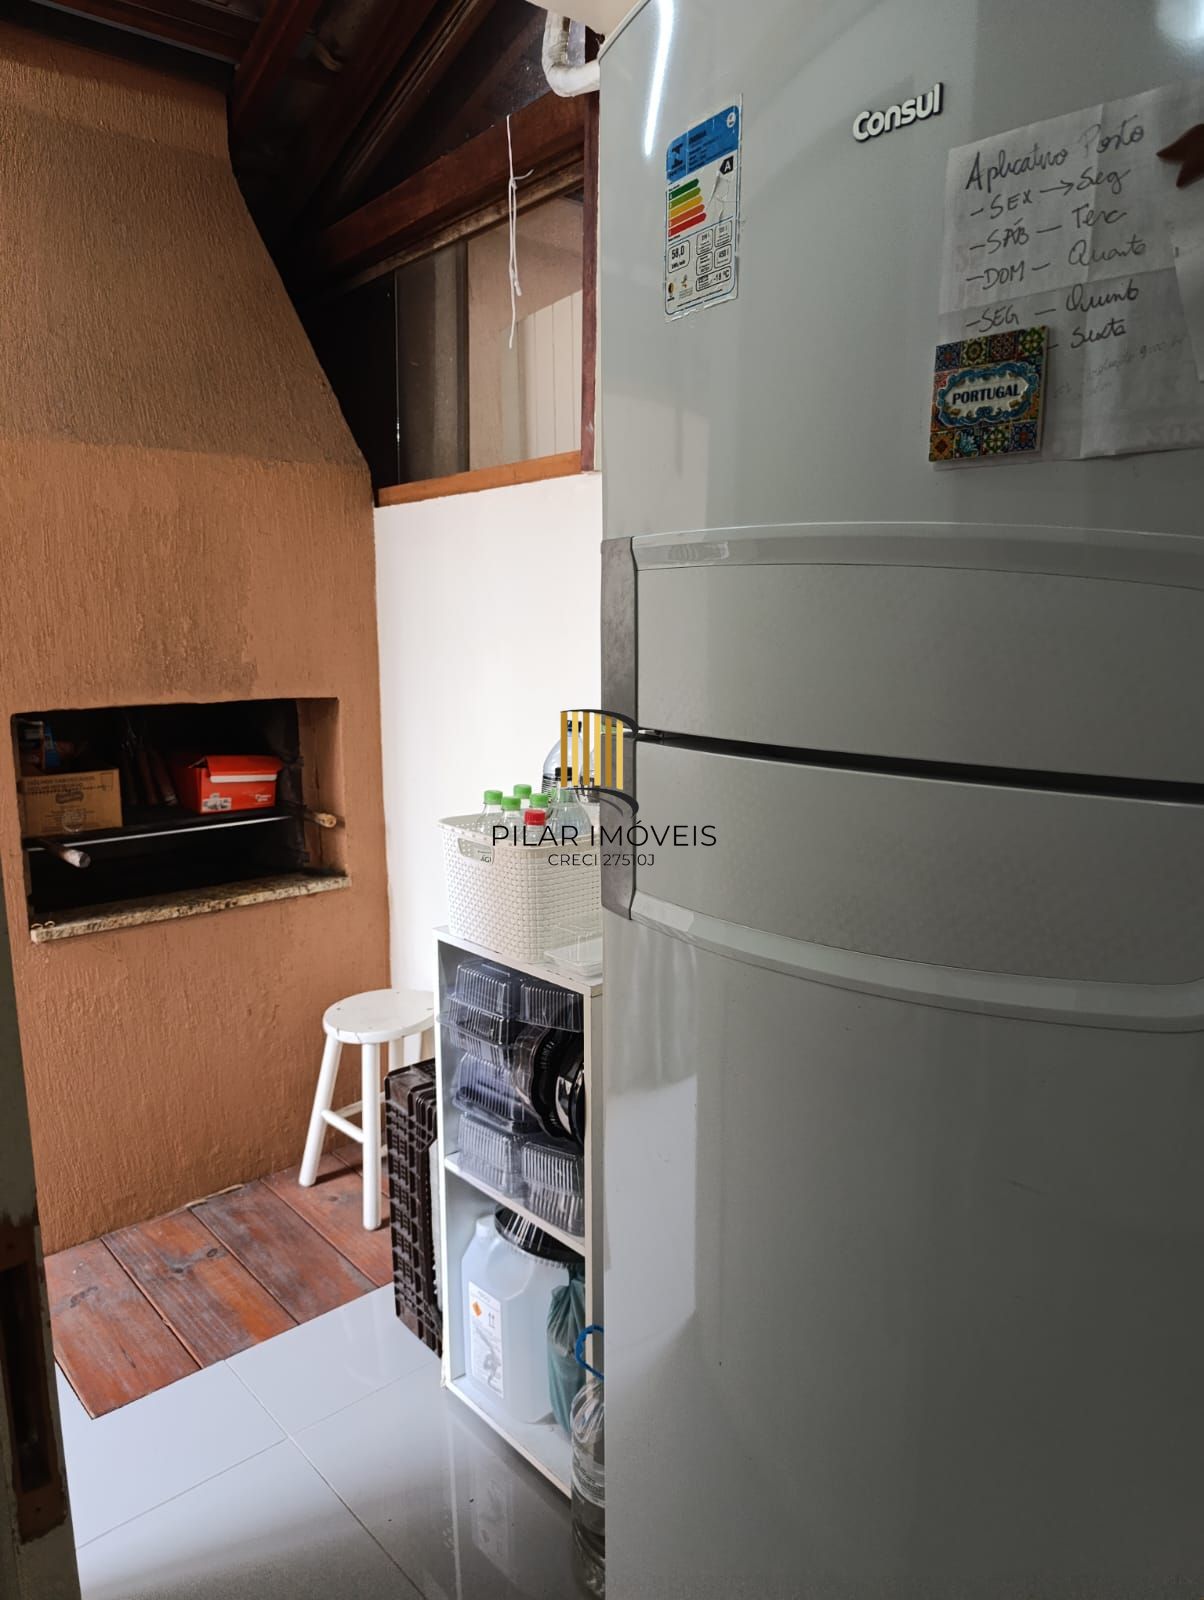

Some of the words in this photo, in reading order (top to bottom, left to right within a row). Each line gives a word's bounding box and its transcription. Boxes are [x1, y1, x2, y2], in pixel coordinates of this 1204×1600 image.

[853, 82, 943, 143] Consul
[965, 143, 1068, 194] Aplicativo
[952, 383, 1021, 406] PORTUGAL
